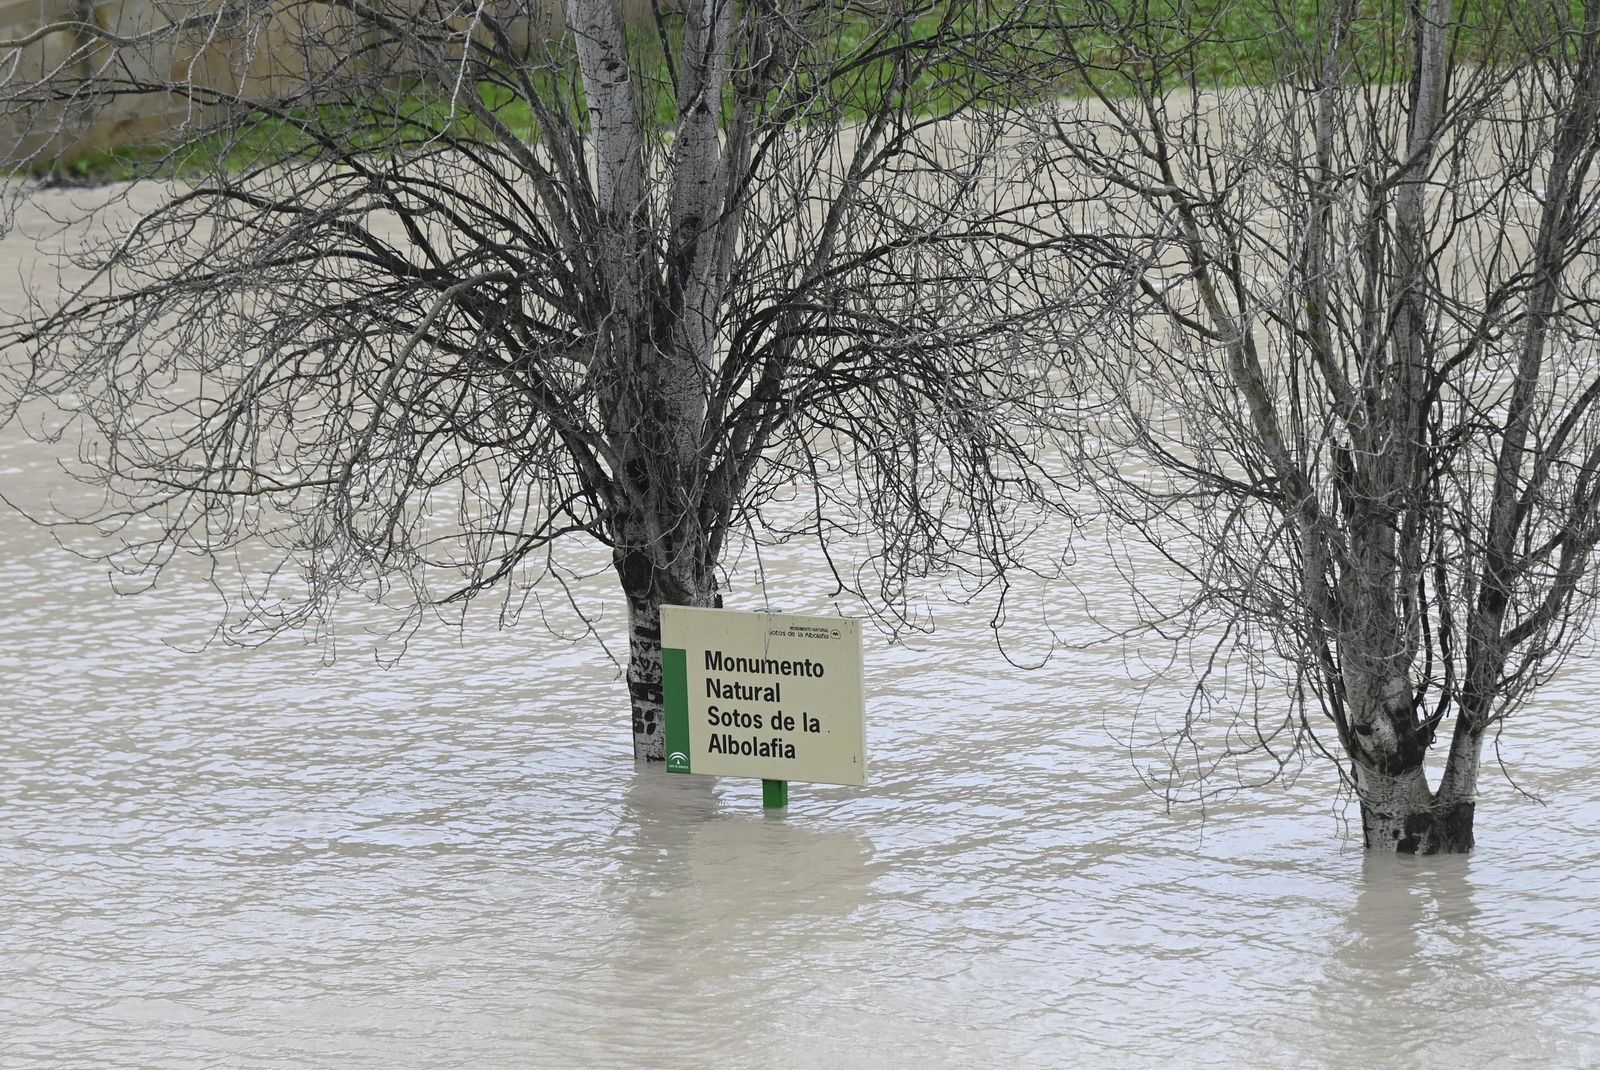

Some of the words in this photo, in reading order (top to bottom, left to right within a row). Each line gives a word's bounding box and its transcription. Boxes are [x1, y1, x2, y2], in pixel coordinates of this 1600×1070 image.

[704, 650, 825, 678] Monumento
[705, 677, 781, 703] Natural
[707, 705, 763, 731] Sotos
[770, 710, 796, 732] de
[802, 711, 821, 734] la
[707, 733, 796, 760] Albolafia
